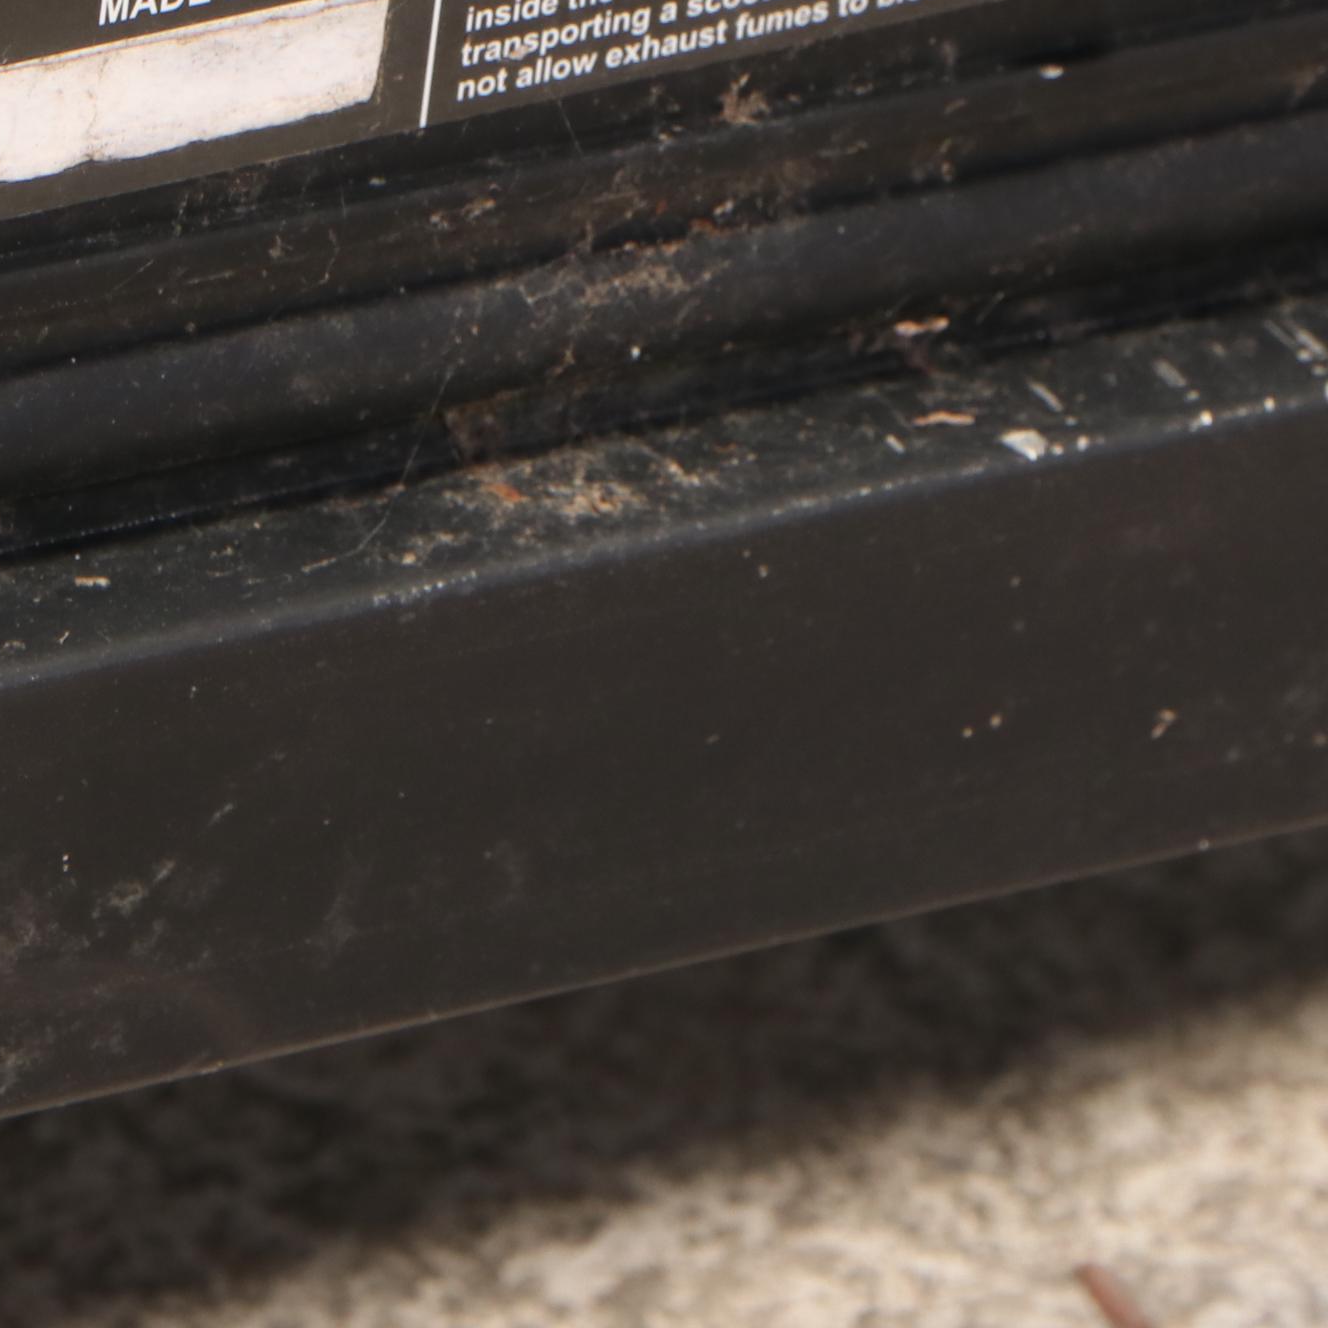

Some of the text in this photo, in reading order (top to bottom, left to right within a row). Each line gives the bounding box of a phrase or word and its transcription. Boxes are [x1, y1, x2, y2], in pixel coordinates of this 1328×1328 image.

[456, 67, 508, 102] not
[515, 52, 598, 89] allow
[604, 19, 728, 69] exhaust
[735, 0, 829, 40] fumes
[461, 7, 651, 67] transporting
[659, 1, 678, 24] a
